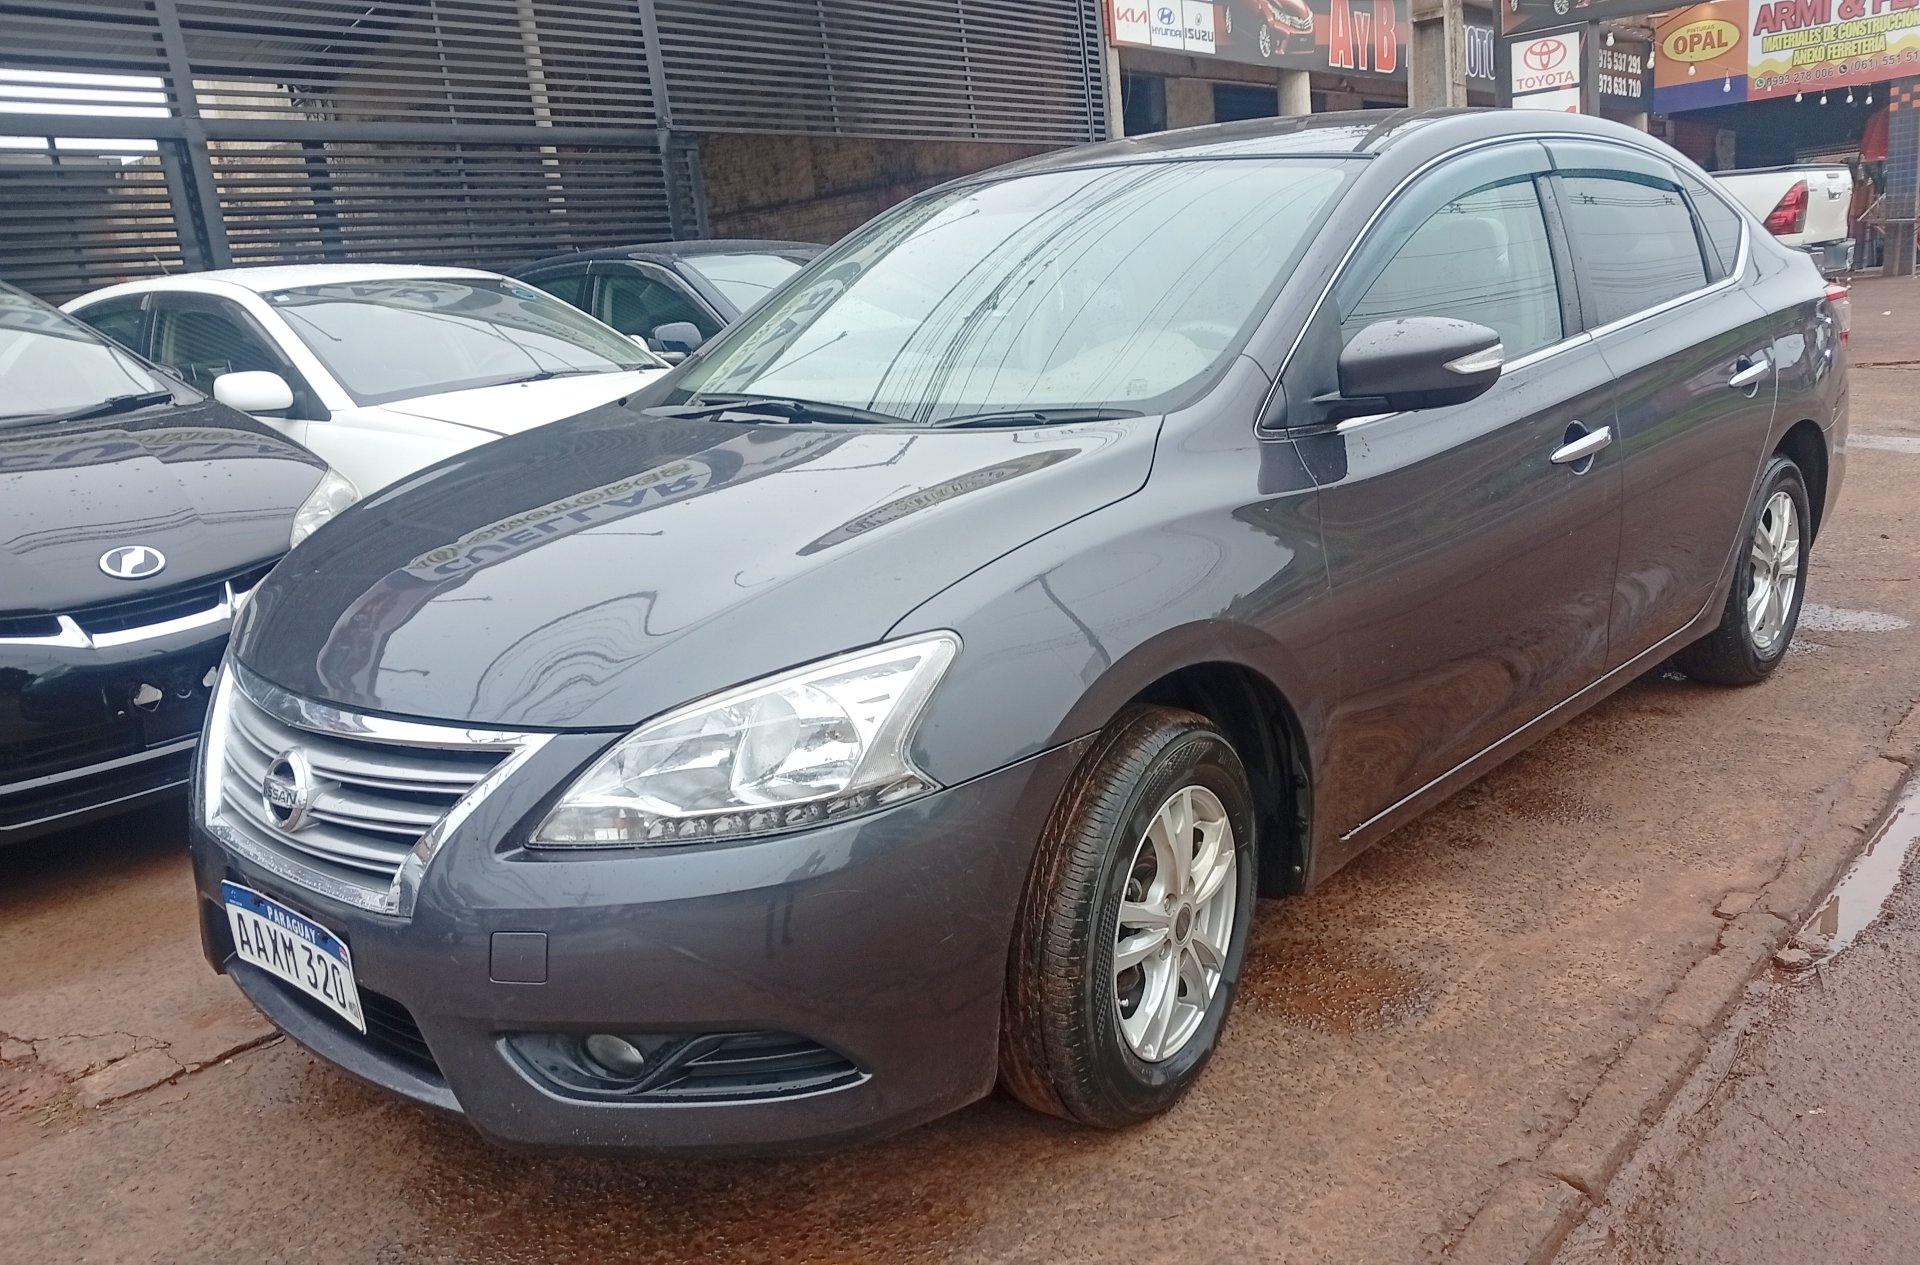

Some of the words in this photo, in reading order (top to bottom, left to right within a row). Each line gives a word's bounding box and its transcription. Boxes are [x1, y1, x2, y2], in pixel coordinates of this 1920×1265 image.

[1116, 6, 1148, 24] KIA
[1184, 27, 1214, 42] ISUZU
[1686, 24, 1715, 34] PINTURAS
[1762, 27, 1822, 53] MATERIALES
[1823, 24, 1837, 40] DE
[1673, 29, 1728, 55] OPAL
[1793, 45, 1825, 66] ANEXO
[1826, 34, 1887, 60] FERRETERÍA
[1613, 51, 1627, 72] 537
[1627, 54, 1642, 75] 291
[1882, 54, 1901, 66] 551
[1516, 70, 1575, 90] TOYOTA
[1793, 71, 1812, 83] 278
[1815, 67, 1834, 78] 006
[1613, 76, 1627, 97] 631
[1628, 78, 1642, 98] 710
[266, 905, 316, 944] PARAGUAY
[237, 912, 299, 979] AAXM
[301, 943, 347, 1008] 320
